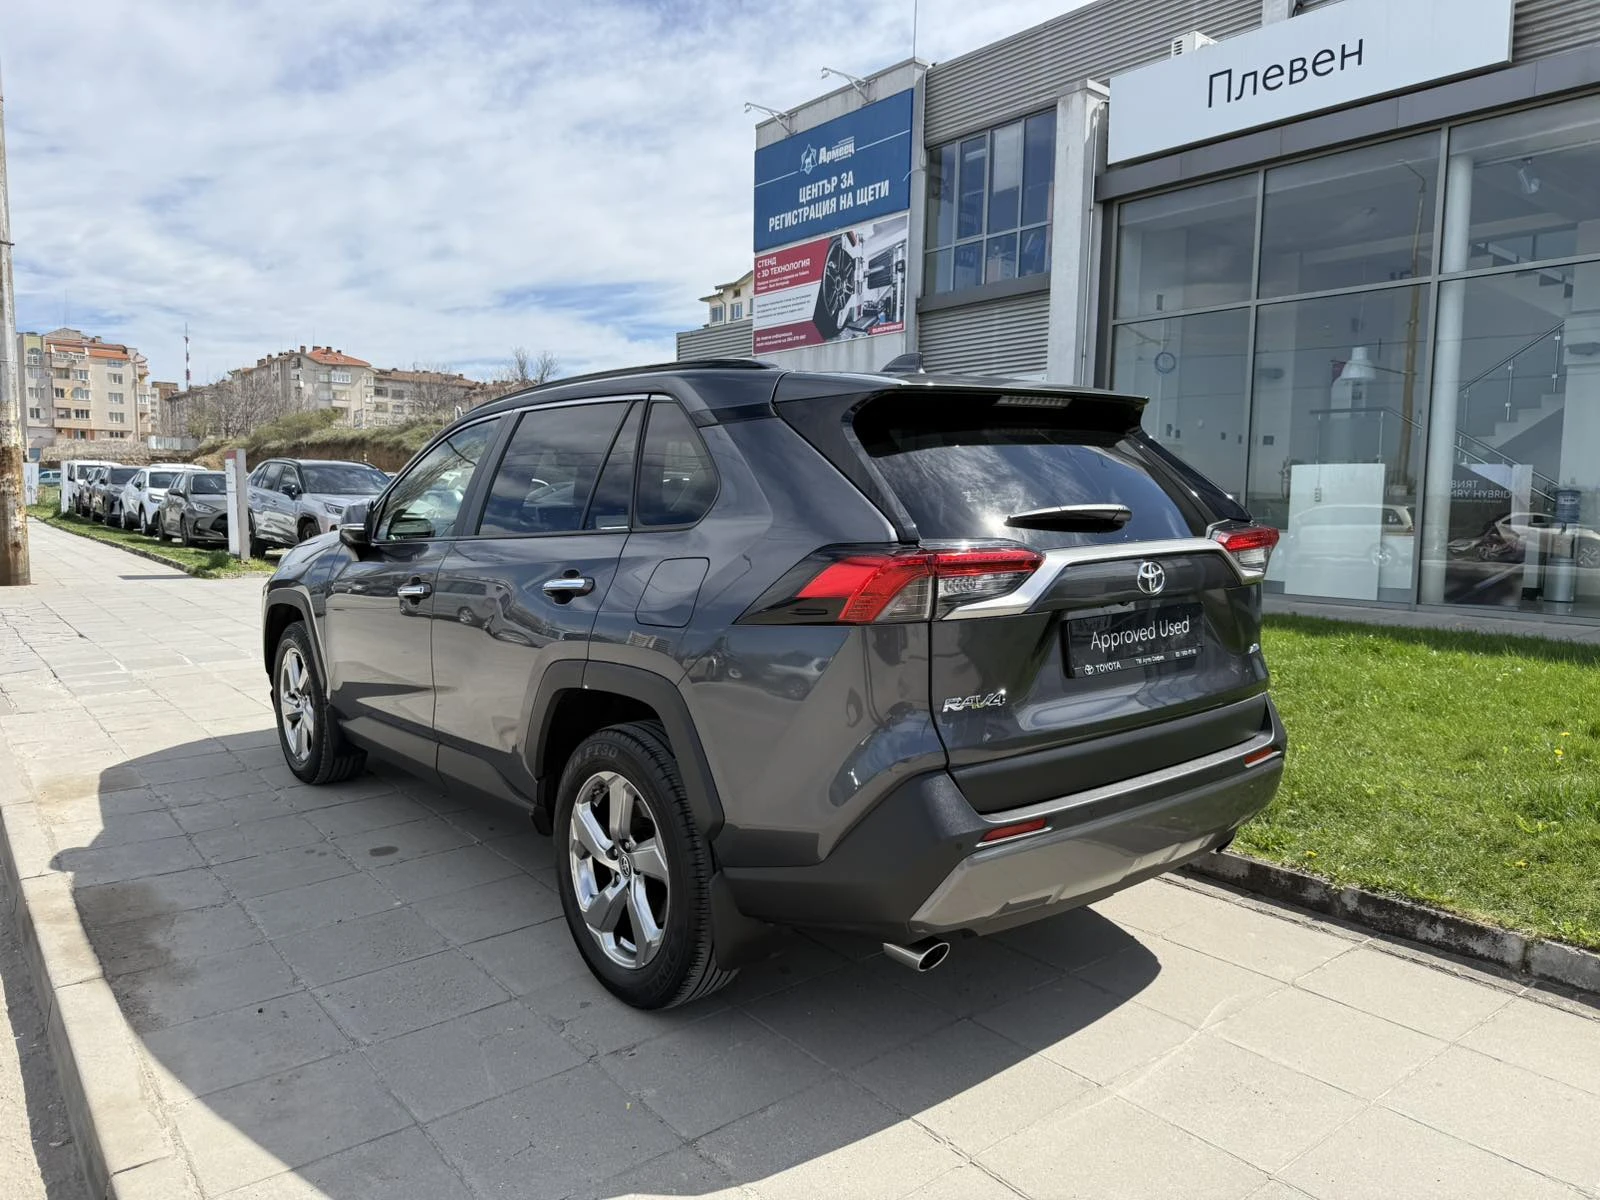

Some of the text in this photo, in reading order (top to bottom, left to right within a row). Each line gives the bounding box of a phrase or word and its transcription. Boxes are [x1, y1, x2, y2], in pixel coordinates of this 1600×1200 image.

[1208, 38, 1364, 108] Плевен
[818, 141, 855, 165] Армеец
[799, 170, 854, 205] ЦЕНТЪР ЗА
[768, 179, 890, 232] РЕГИСТРАЦИЯ НА ЩЕТИ
[757, 256, 777, 268] СТЕНД
[770, 258, 811, 275] ТЕХНОЛОГИЯ
[1450, 480, 1478, 489] ВИЯТ
[1473, 489, 1512, 499] HYBRID
[1090, 614, 1190, 653] Approved Used
[1095, 660, 1121, 673] TOYOTA
[942, 688, 1006, 712] RAV4
